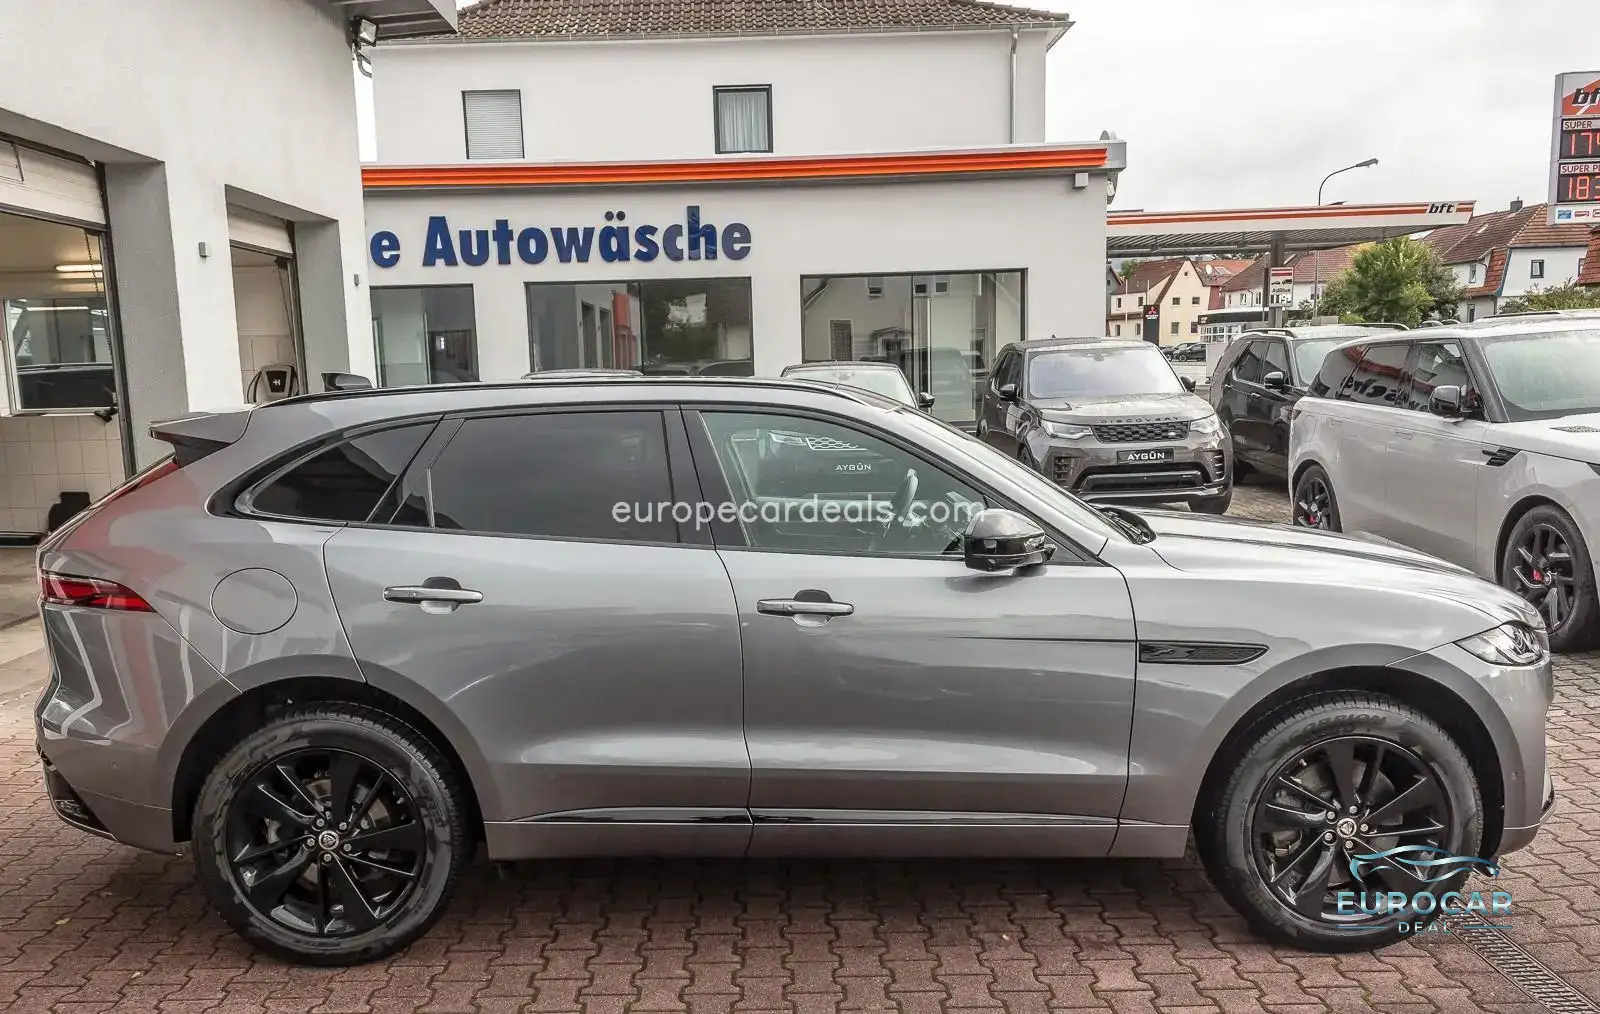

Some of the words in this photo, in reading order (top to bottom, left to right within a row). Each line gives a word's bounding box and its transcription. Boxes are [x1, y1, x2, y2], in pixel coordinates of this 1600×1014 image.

[1564, 121, 1592, 129] SUPER
[1571, 132, 1600, 155] 17
[1561, 165, 1590, 173] SUPER
[1428, 203, 1455, 214] bft
[370, 230, 401, 268] e
[422, 205, 752, 267] Autowäsche
[1100, 416, 1179, 424] DISCOVERY
[1127, 451, 1165, 461] AYGÜN
[836, 462, 871, 471] AYGÜN
